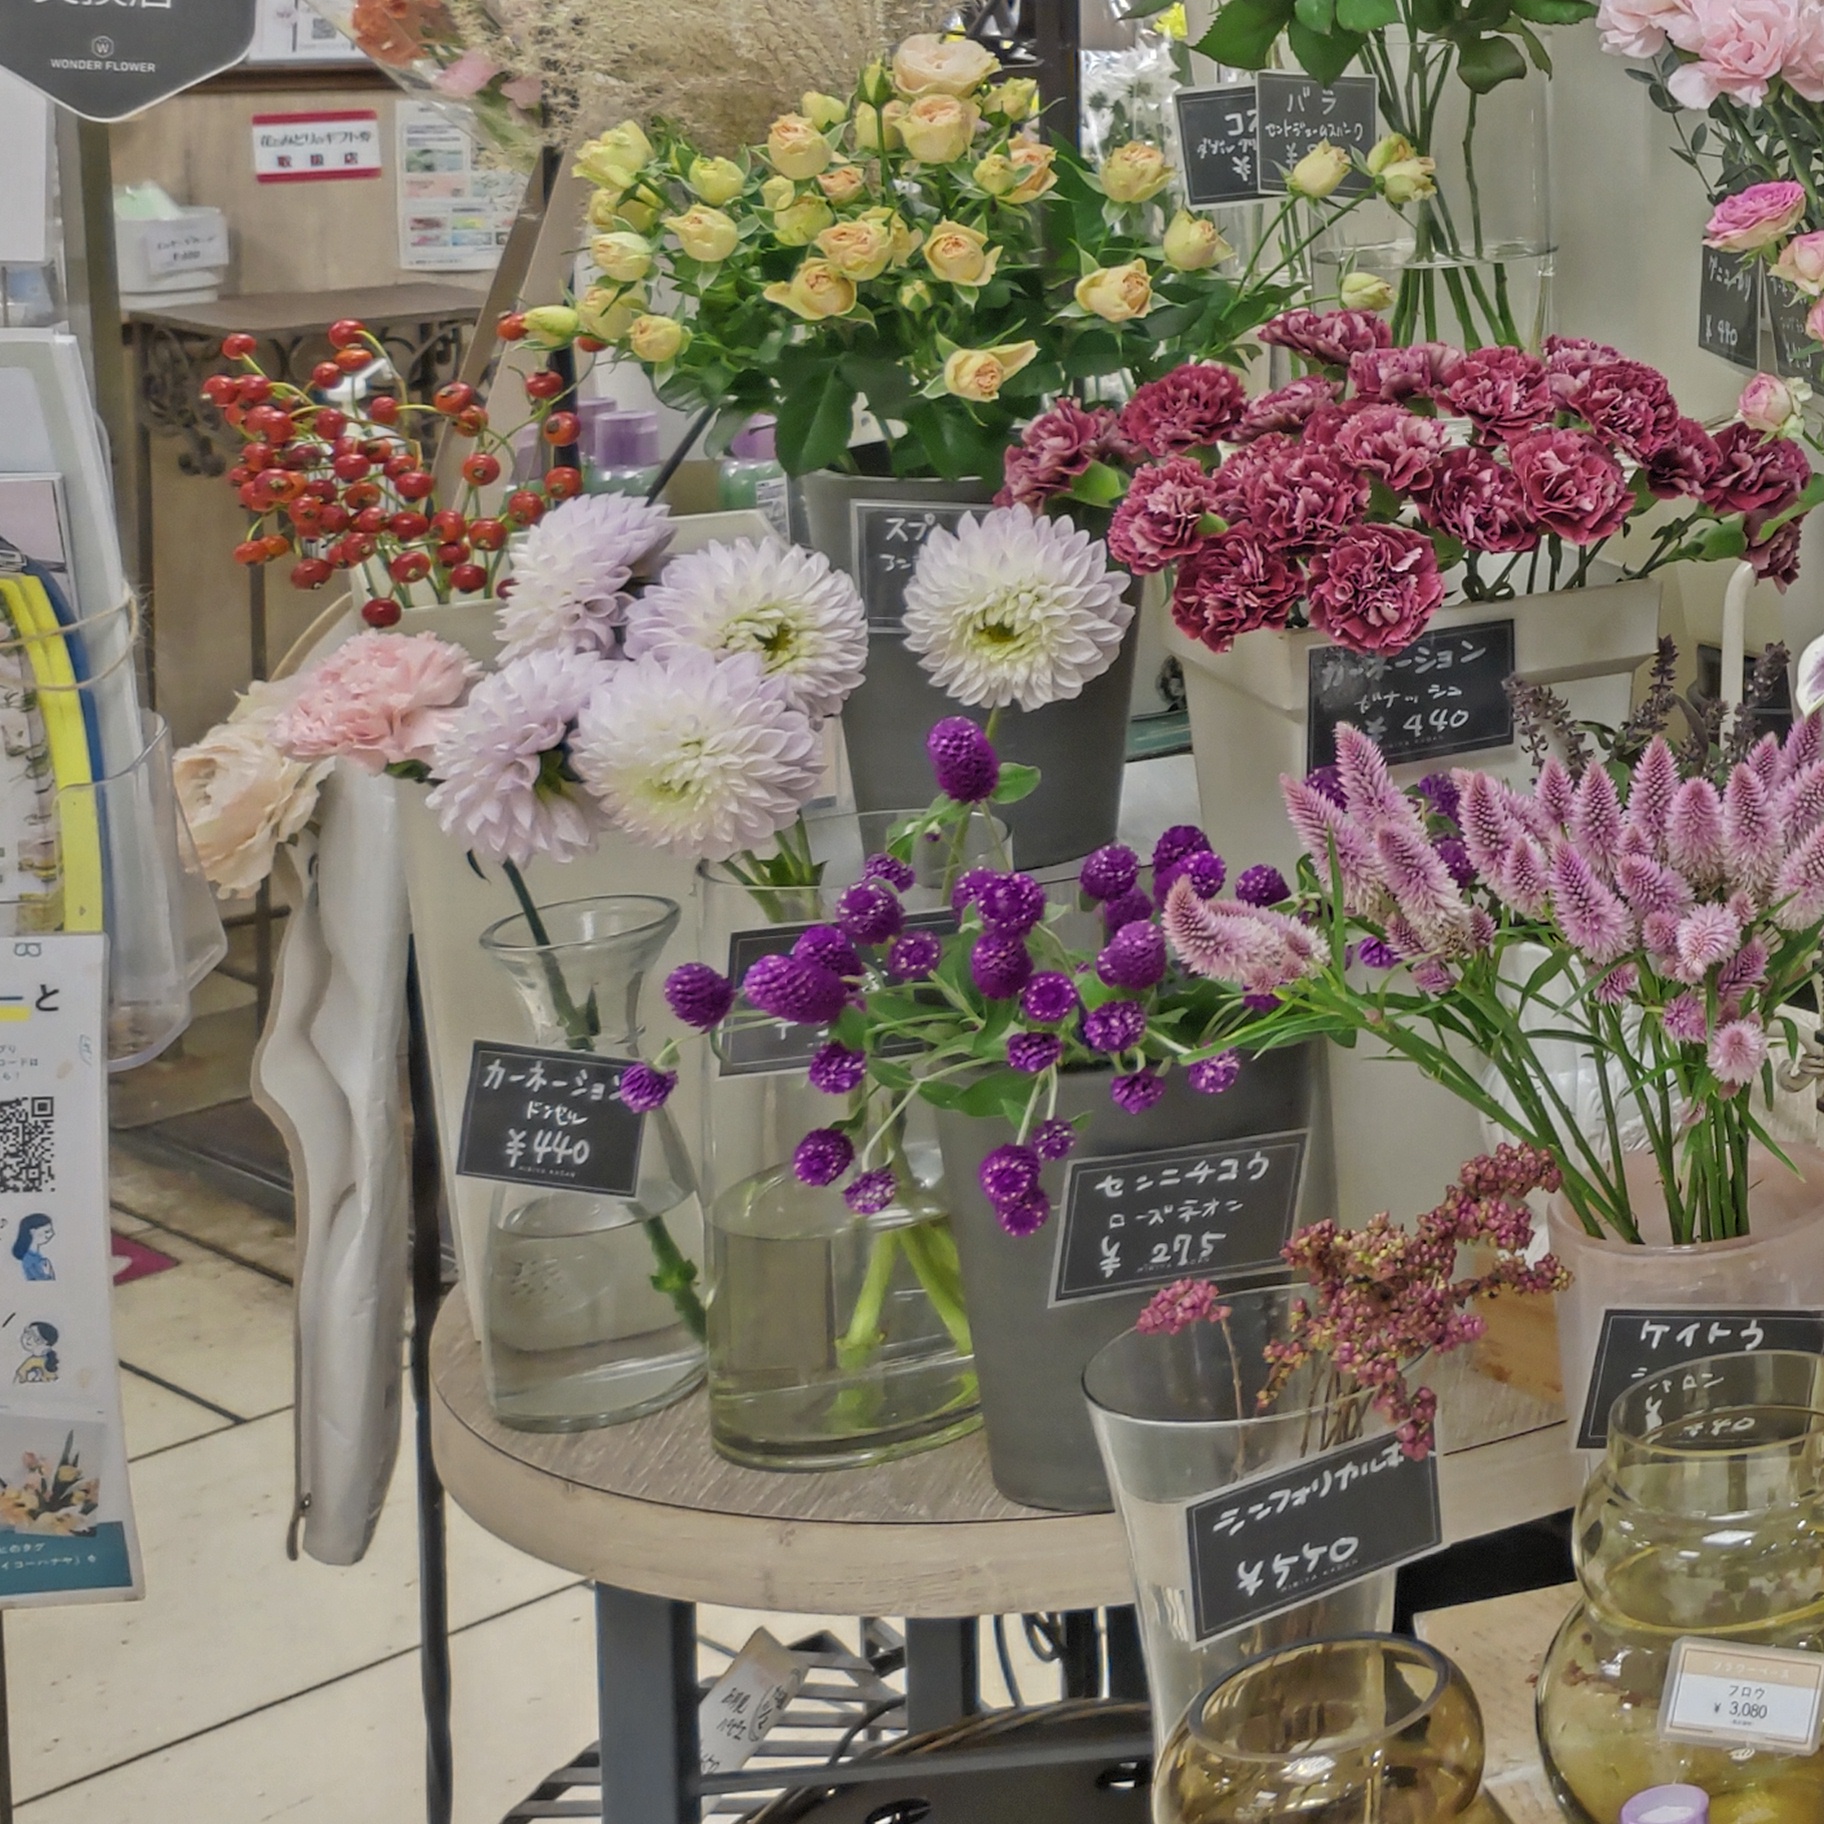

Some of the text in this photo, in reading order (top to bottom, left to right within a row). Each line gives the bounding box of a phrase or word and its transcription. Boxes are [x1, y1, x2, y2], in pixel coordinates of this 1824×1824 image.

[50, 58, 156, 73] WONDER FLOWER
[1286, 86, 1337, 115] バラ
[505, 1128, 591, 1168] ¥440
[1094, 1150, 1270, 1198] センニチコウ
[1109, 1197, 1244, 1229] ローズネオン
[1640, 1319, 1764, 1351] ケイトウ
[1728, 1685, 1766, 1700] フロウ
